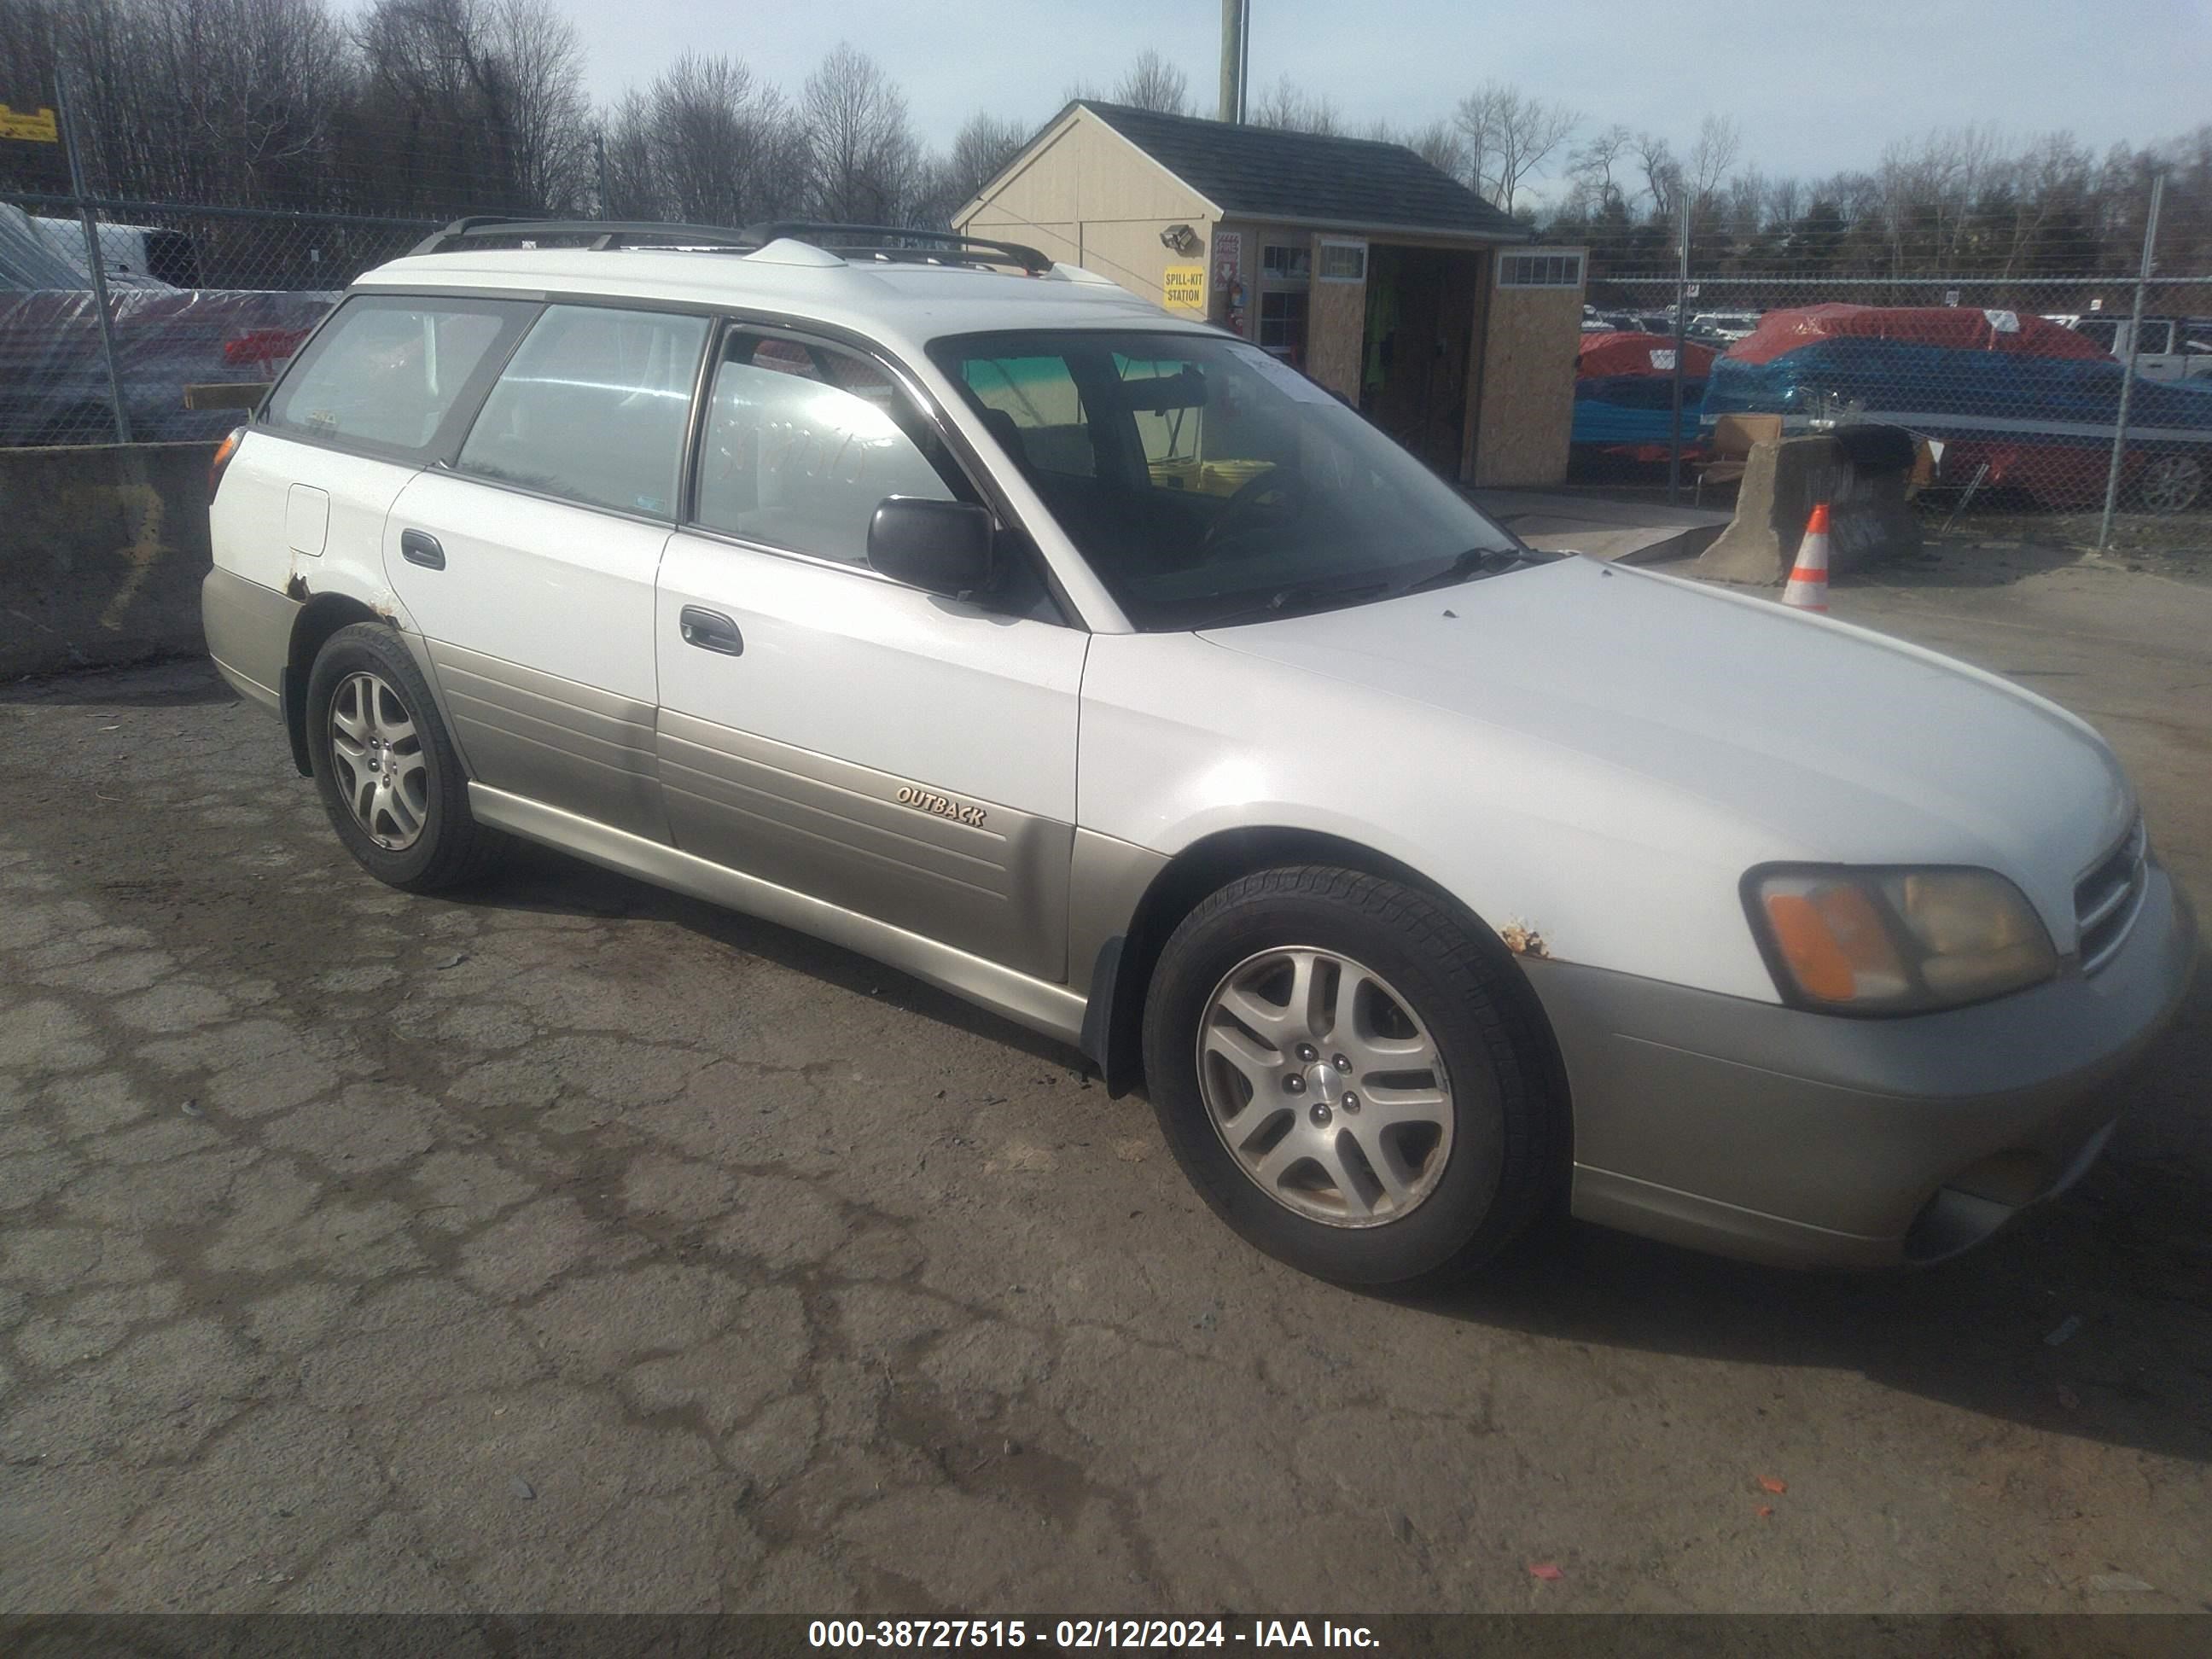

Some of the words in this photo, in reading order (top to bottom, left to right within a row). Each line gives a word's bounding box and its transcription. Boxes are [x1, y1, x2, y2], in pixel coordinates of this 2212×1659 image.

[1166, 273, 1203, 286] SPILL-KIT
[1167, 289, 1200, 301] STATION
[896, 786, 987, 828] OUTBACK
